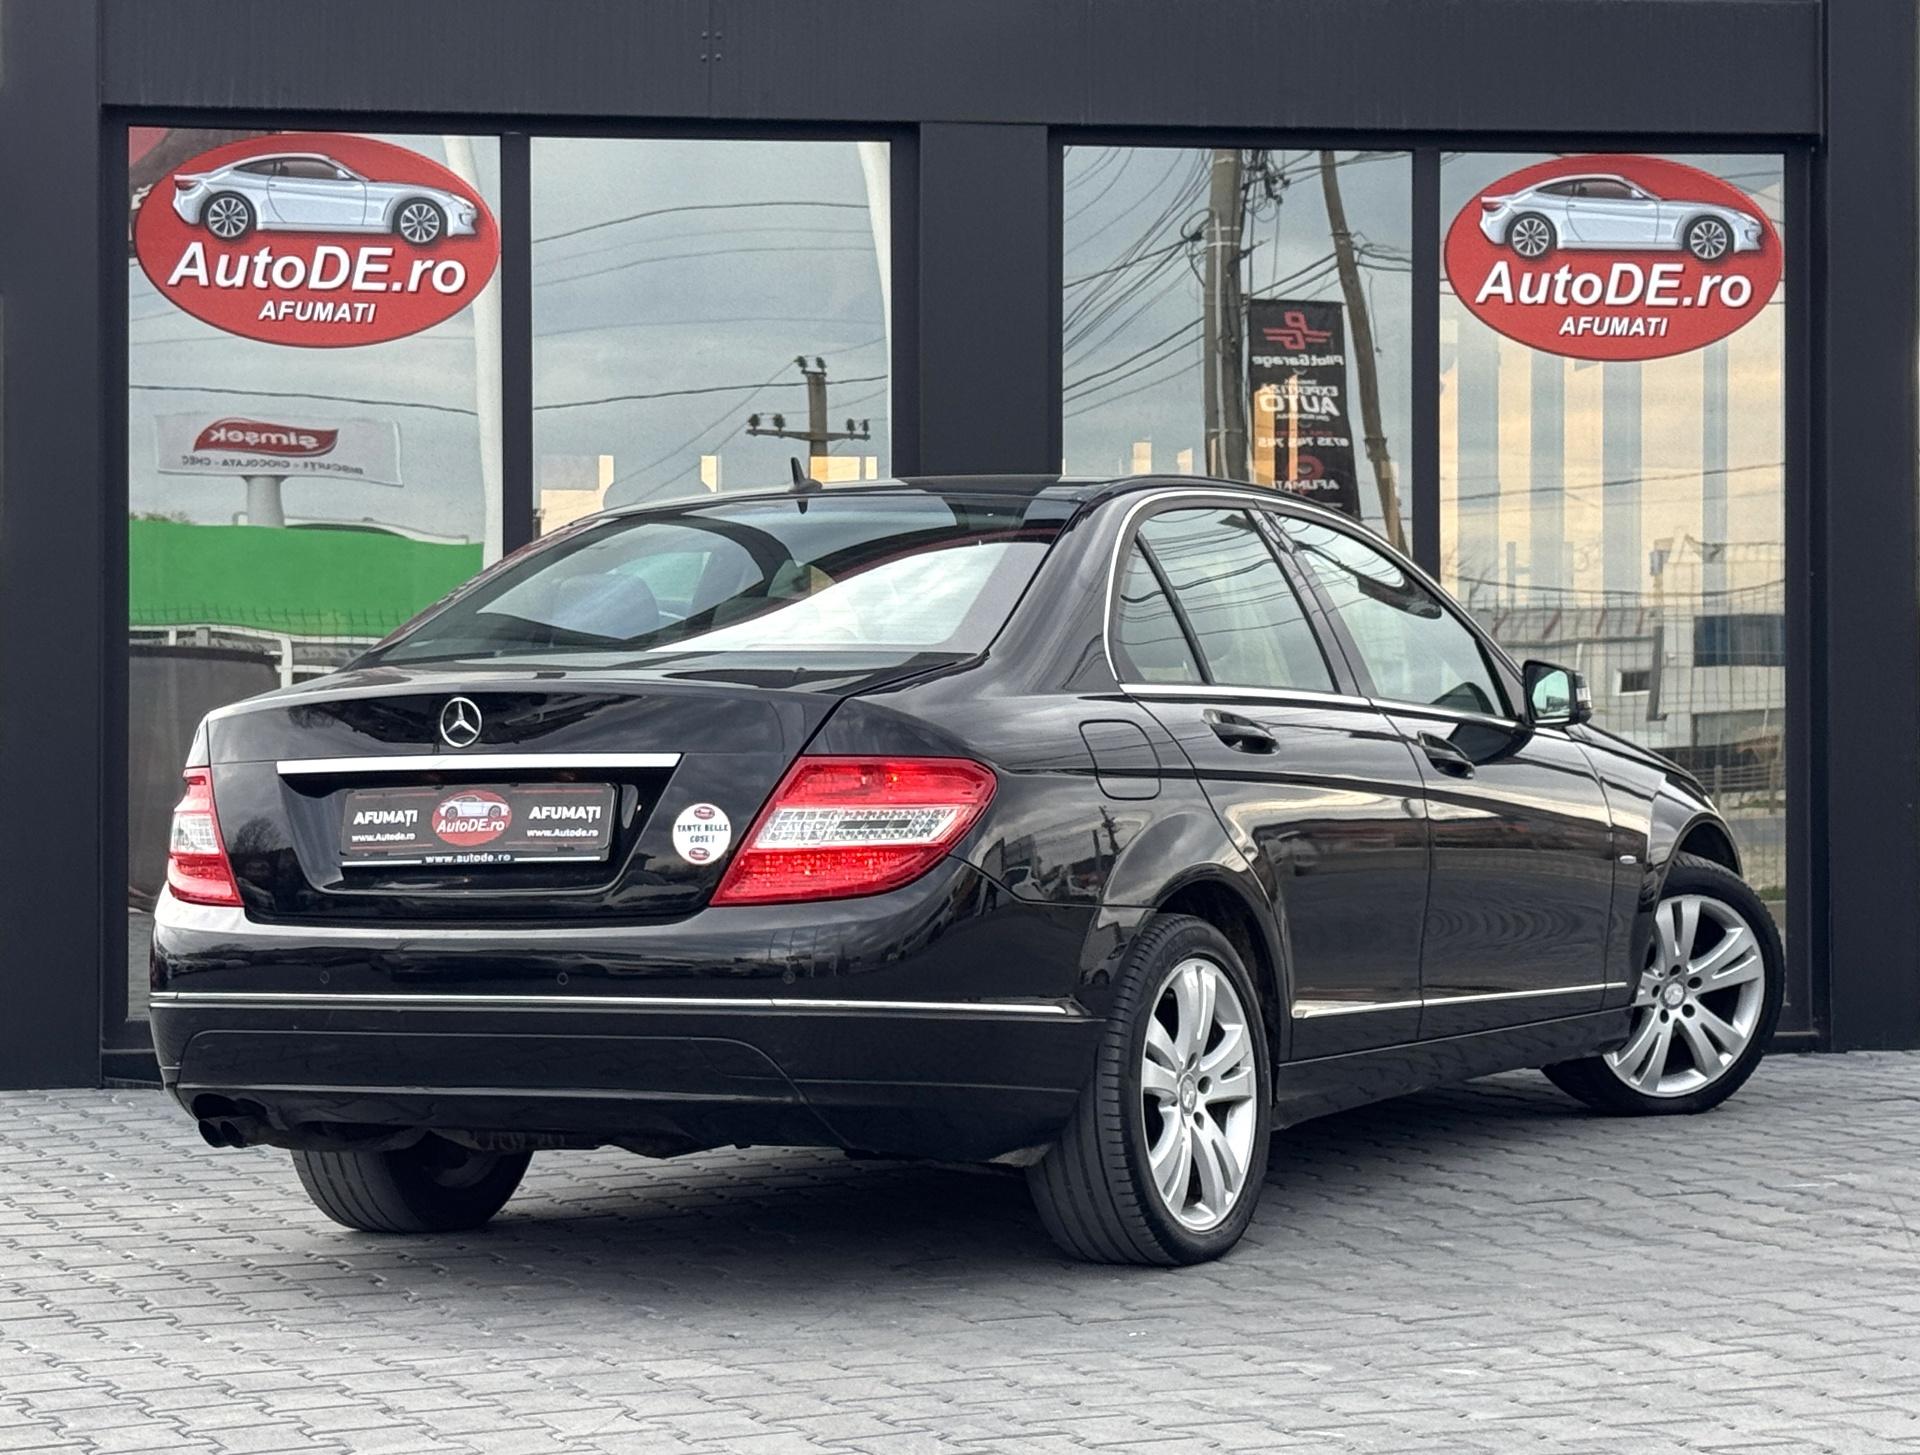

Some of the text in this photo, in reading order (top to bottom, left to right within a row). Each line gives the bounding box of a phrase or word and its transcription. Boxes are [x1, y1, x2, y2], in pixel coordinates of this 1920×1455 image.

[167, 241, 467, 294] AutoDE.ro
[1475, 260, 1753, 308] AutoDE.ro
[258, 300, 377, 323] AFUMATI
[1559, 316, 1668, 337] AFUMATI
[436, 818, 505, 834] AutoDE.ro
[425, 853, 511, 864] www.autode.ro
